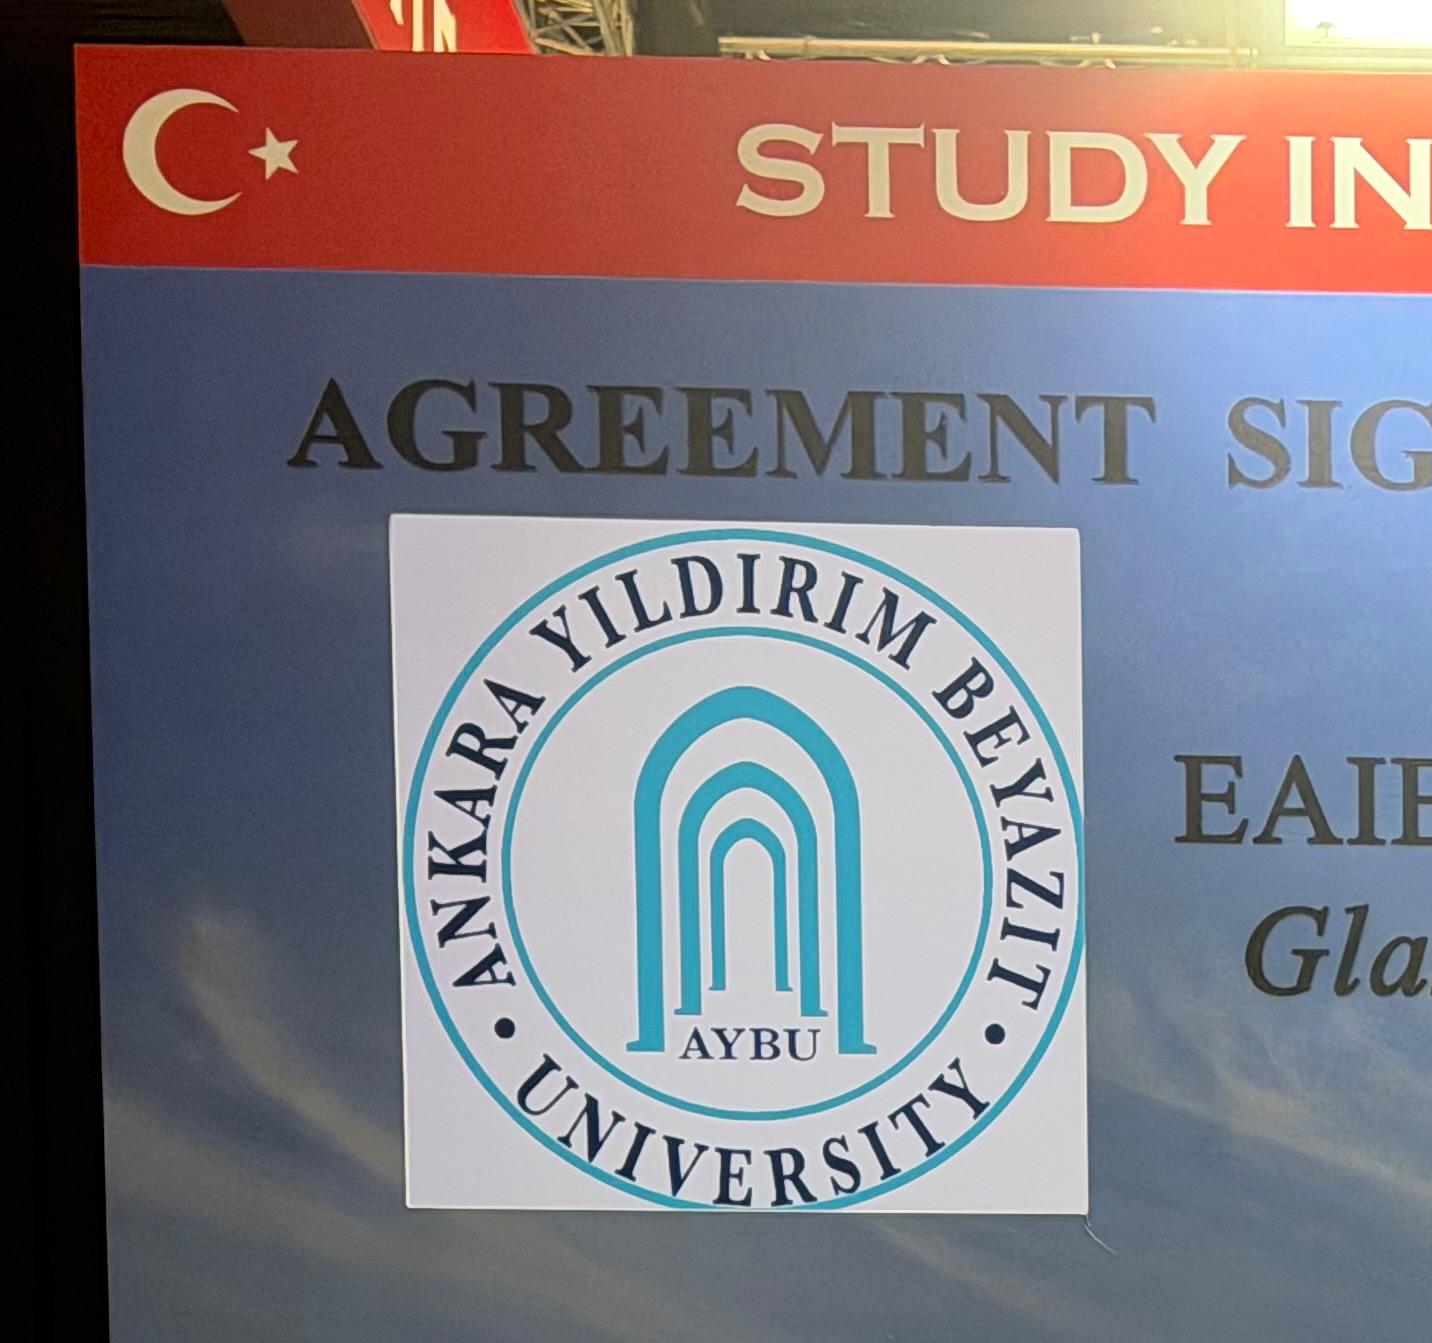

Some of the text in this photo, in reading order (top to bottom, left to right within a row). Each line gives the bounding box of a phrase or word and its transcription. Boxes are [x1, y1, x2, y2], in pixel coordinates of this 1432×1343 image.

[735, 121, 1247, 227] STUDY
[287, 378, 1157, 486] AGREEMENT
[428, 553, 1065, 1011] ANKARA YILDIRIM BEYAZIT
[678, 1026, 821, 1061] AYBU
[516, 1053, 990, 1208] UNIVERSITY
